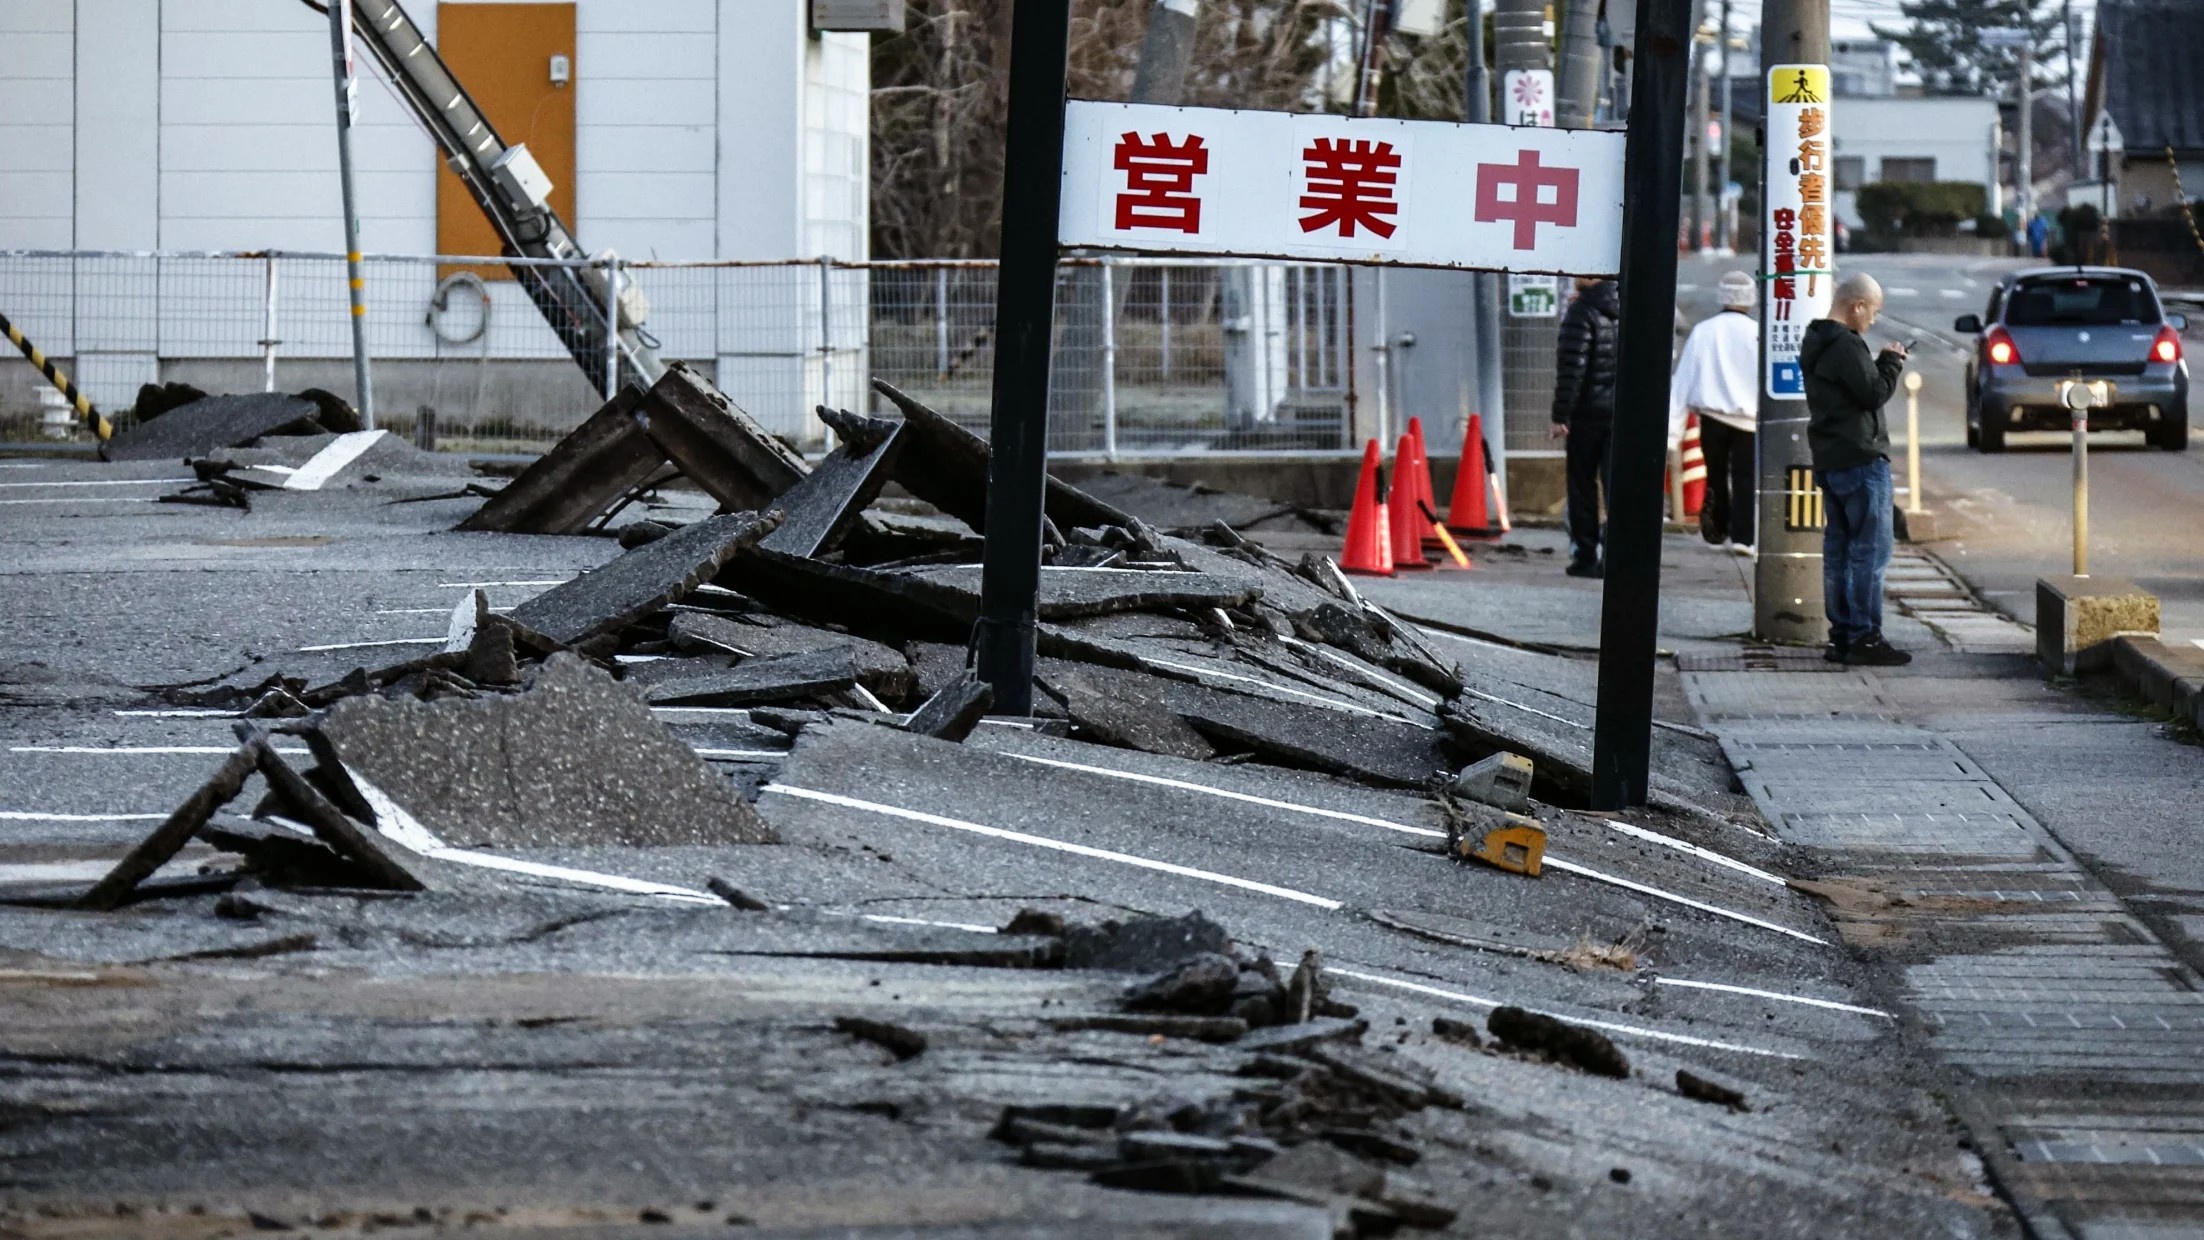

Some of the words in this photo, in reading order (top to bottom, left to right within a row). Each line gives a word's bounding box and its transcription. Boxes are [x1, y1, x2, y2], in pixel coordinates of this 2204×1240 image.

[1114, 131, 1579, 250] 営業中
[1798, 107, 1826, 298] 歩行者優先!
